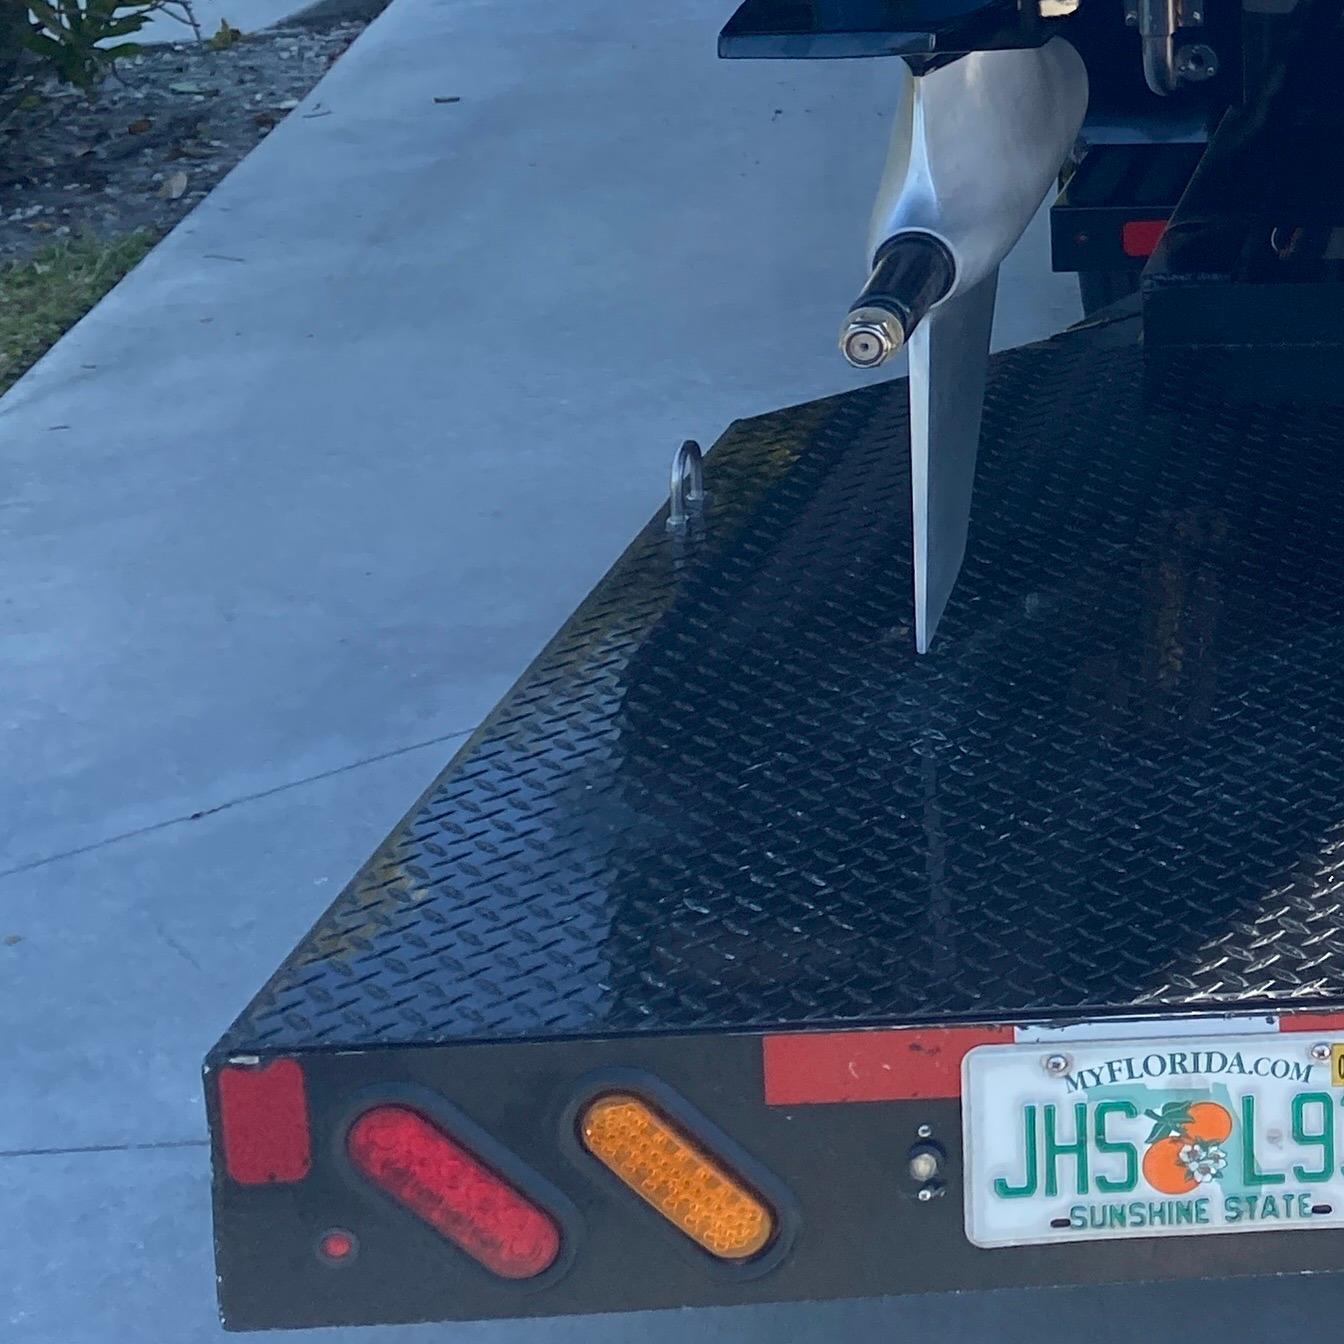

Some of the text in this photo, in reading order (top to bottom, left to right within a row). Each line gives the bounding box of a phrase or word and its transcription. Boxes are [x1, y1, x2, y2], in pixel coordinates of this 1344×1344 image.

[1065, 1051, 1314, 1094] MYFLORIDA.COM
[994, 1100, 1137, 1198] JHS
[1069, 1193, 1314, 1230] SUNSHINE STATE
